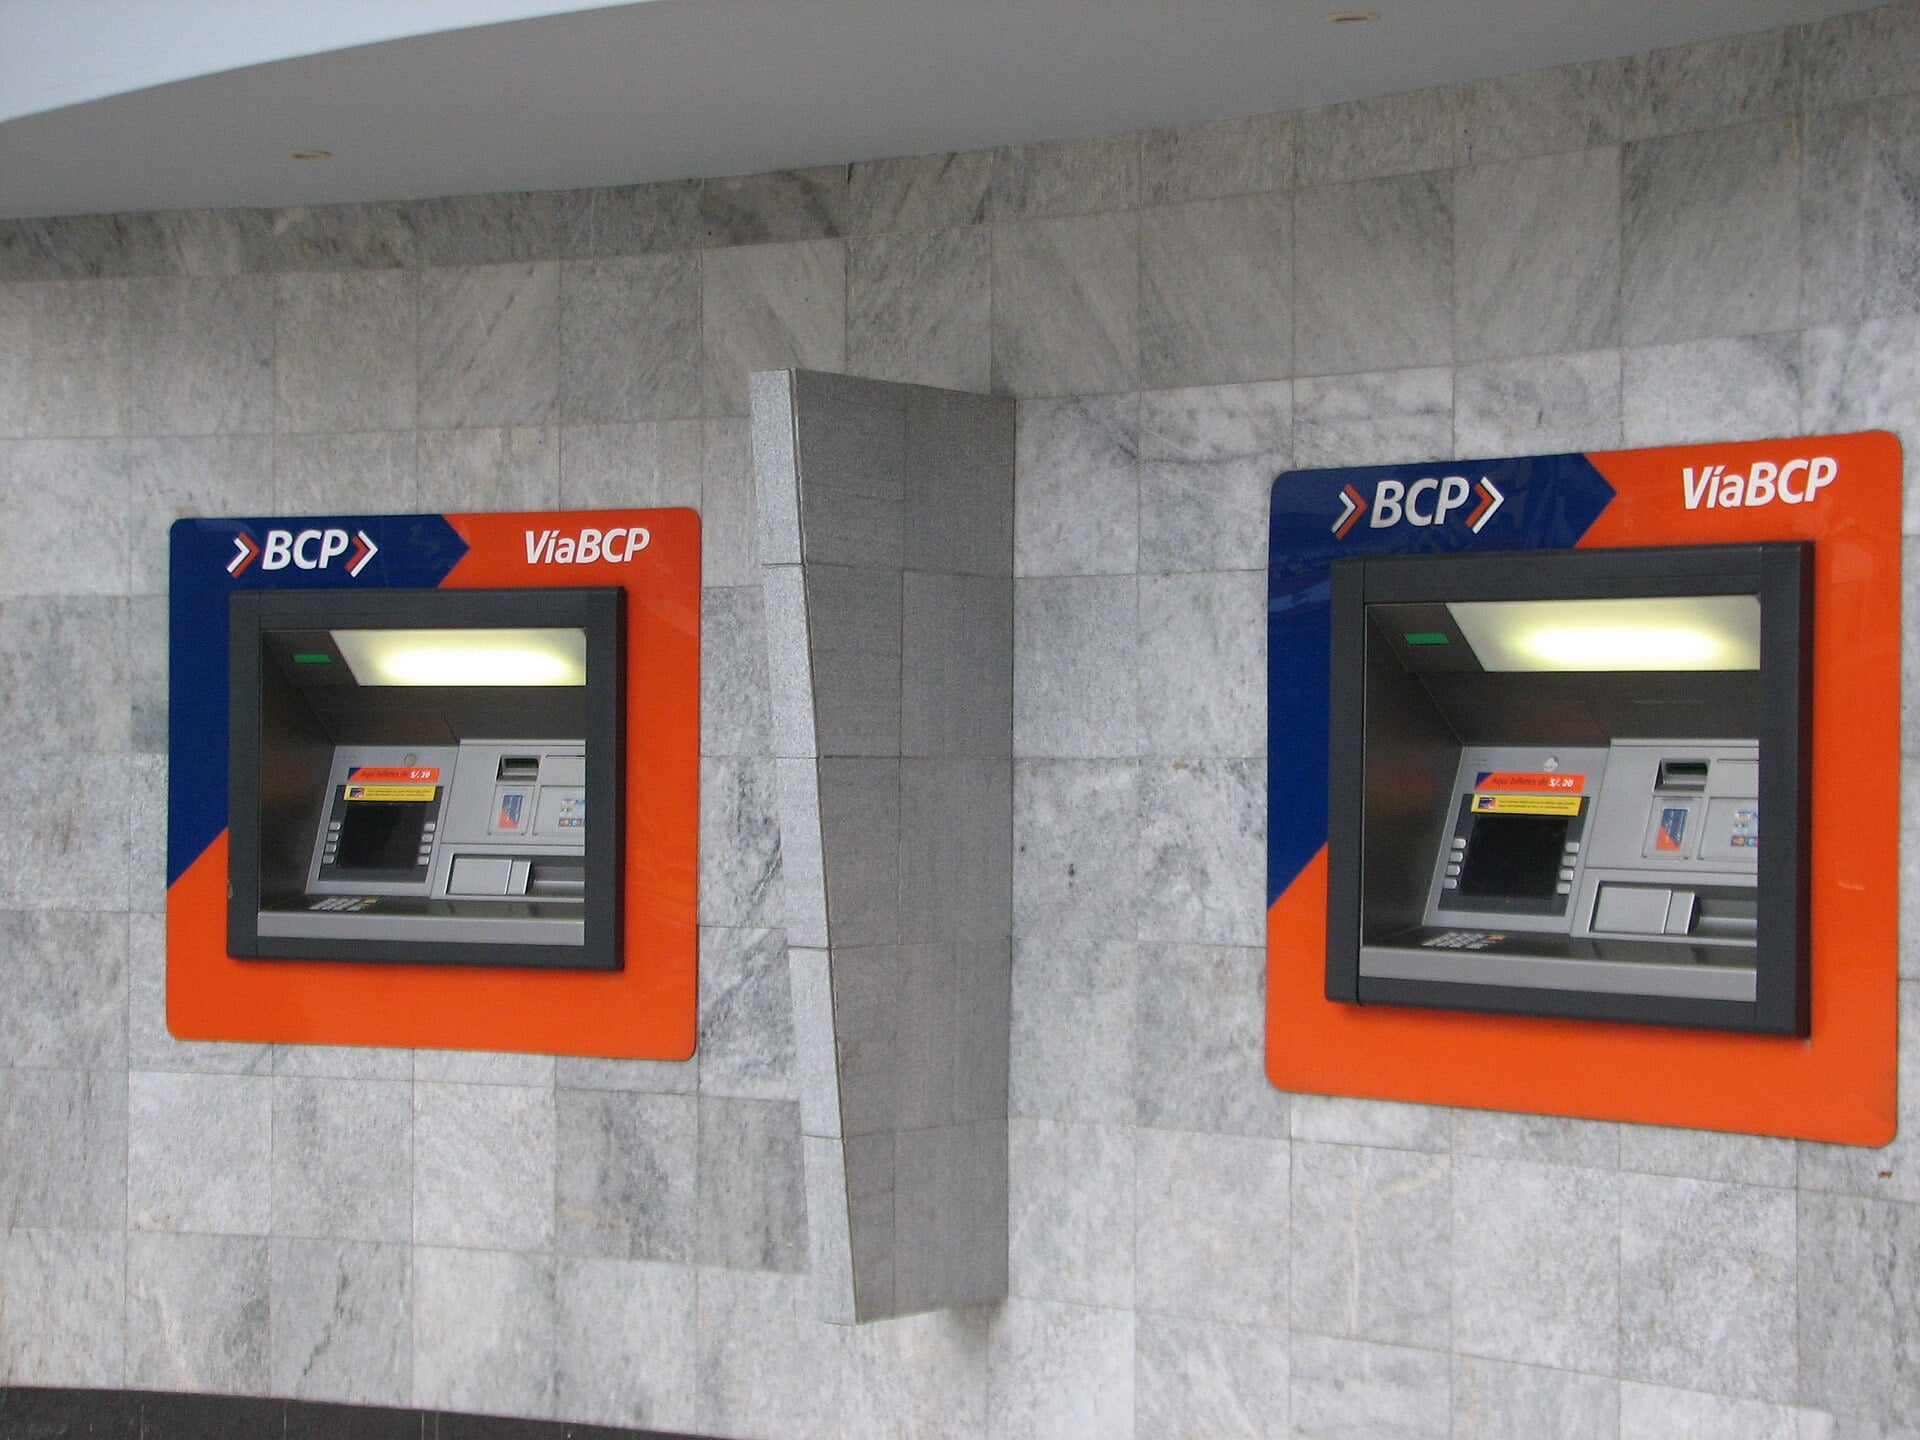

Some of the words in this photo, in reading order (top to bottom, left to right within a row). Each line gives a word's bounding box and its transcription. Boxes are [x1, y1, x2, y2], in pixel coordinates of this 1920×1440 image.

[1370, 476, 1470, 529] BCP
[1683, 456, 1838, 510] VíaBCP
[261, 529, 349, 570] BCP
[525, 527, 650, 564] VíaBCP
